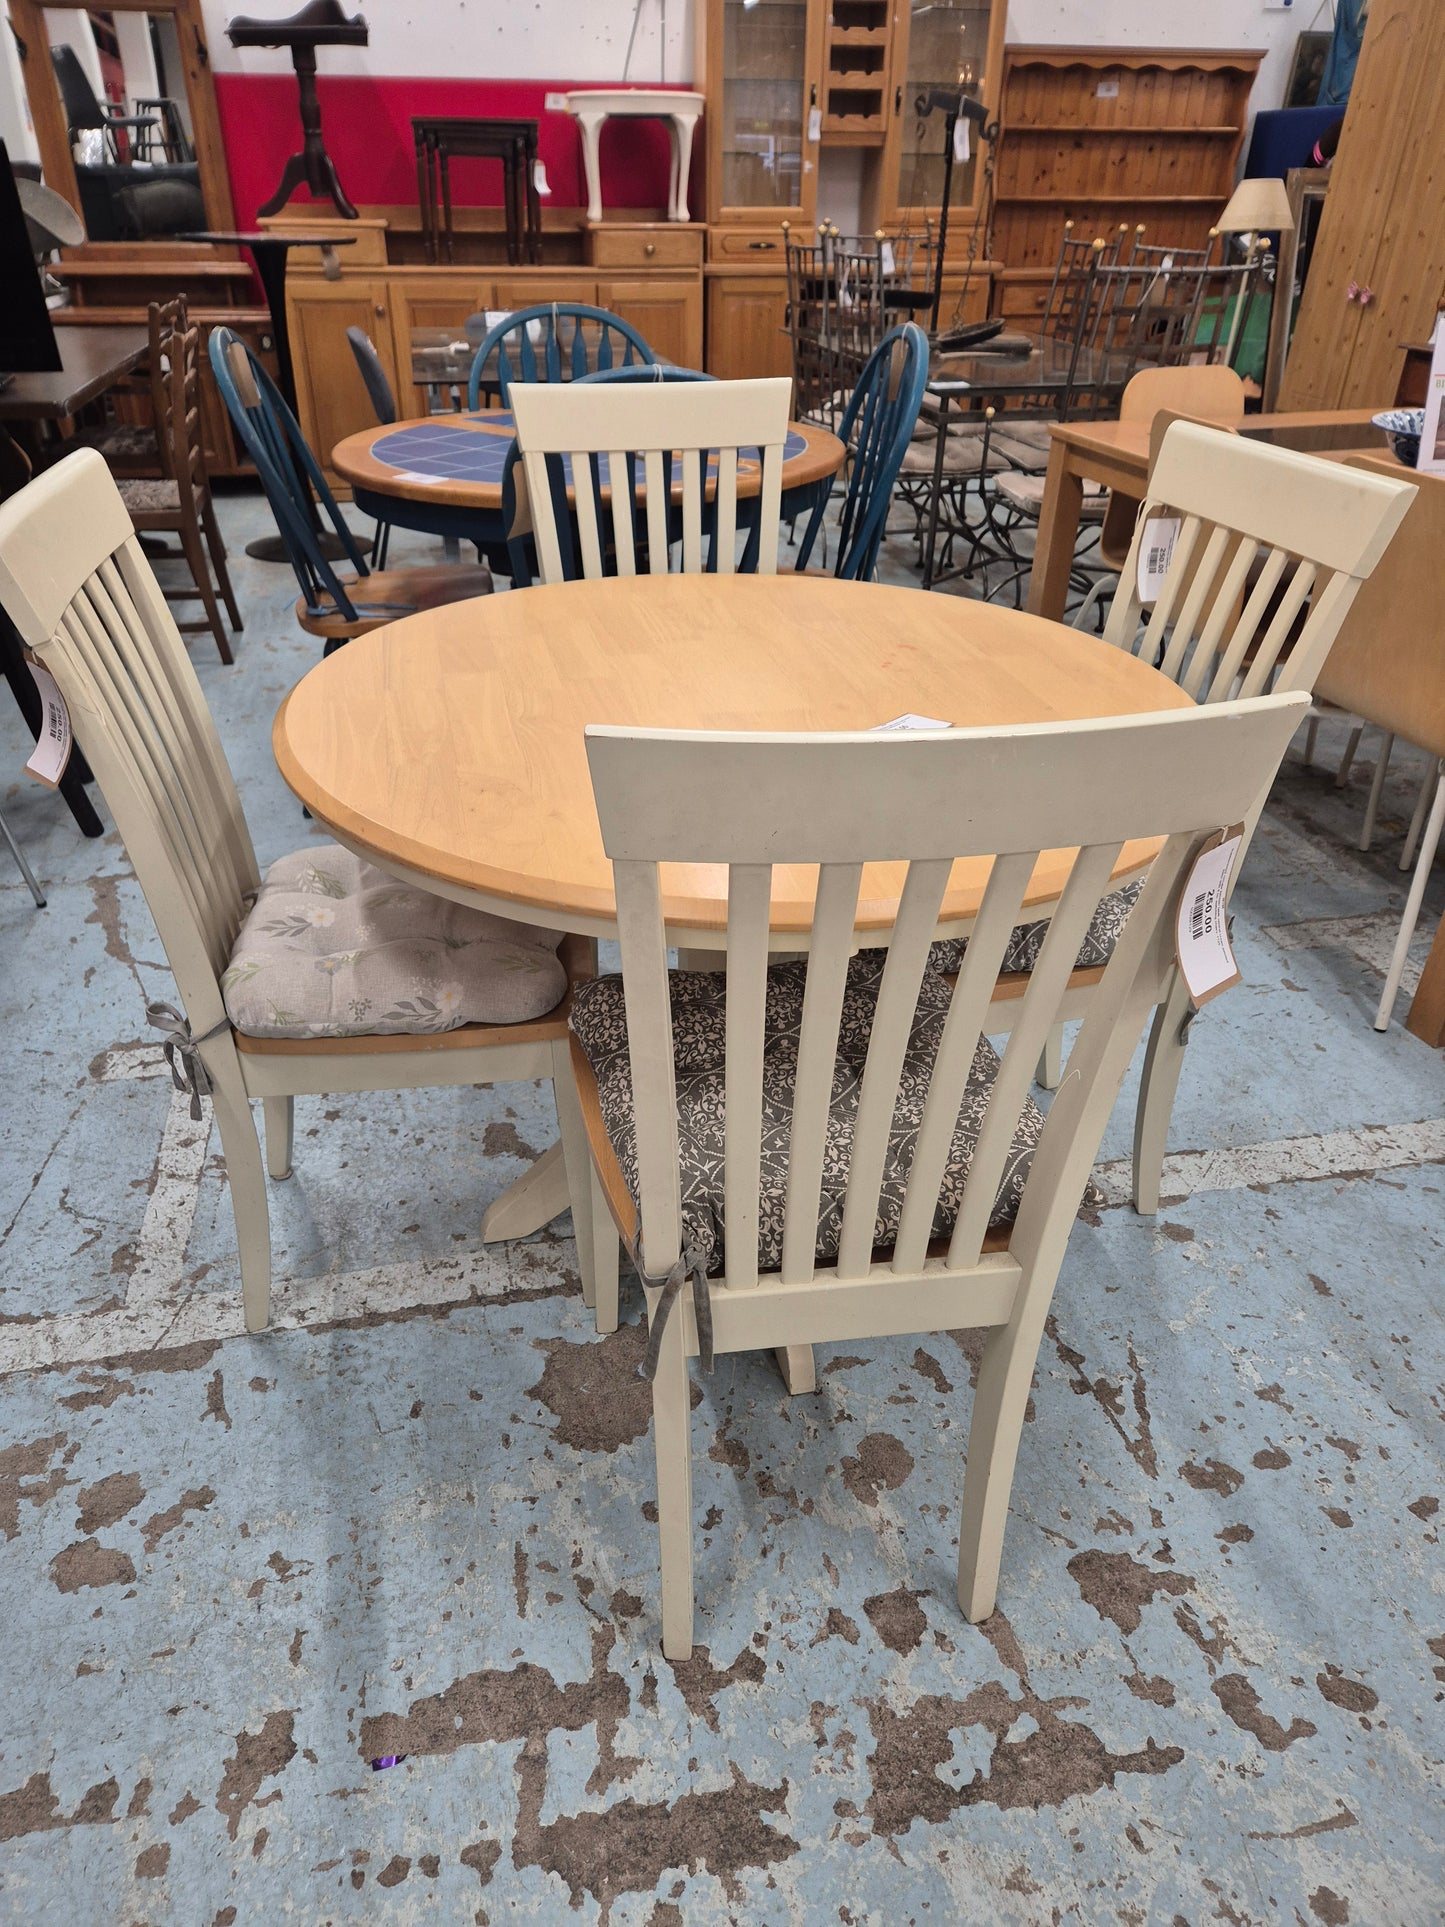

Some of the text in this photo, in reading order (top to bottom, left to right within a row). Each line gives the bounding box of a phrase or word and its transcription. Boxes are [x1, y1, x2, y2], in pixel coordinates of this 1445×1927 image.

[1157, 547, 1166, 574] 250.00
[55, 705, 63, 742] 250.00
[1204, 888, 1215, 934] 250.00
